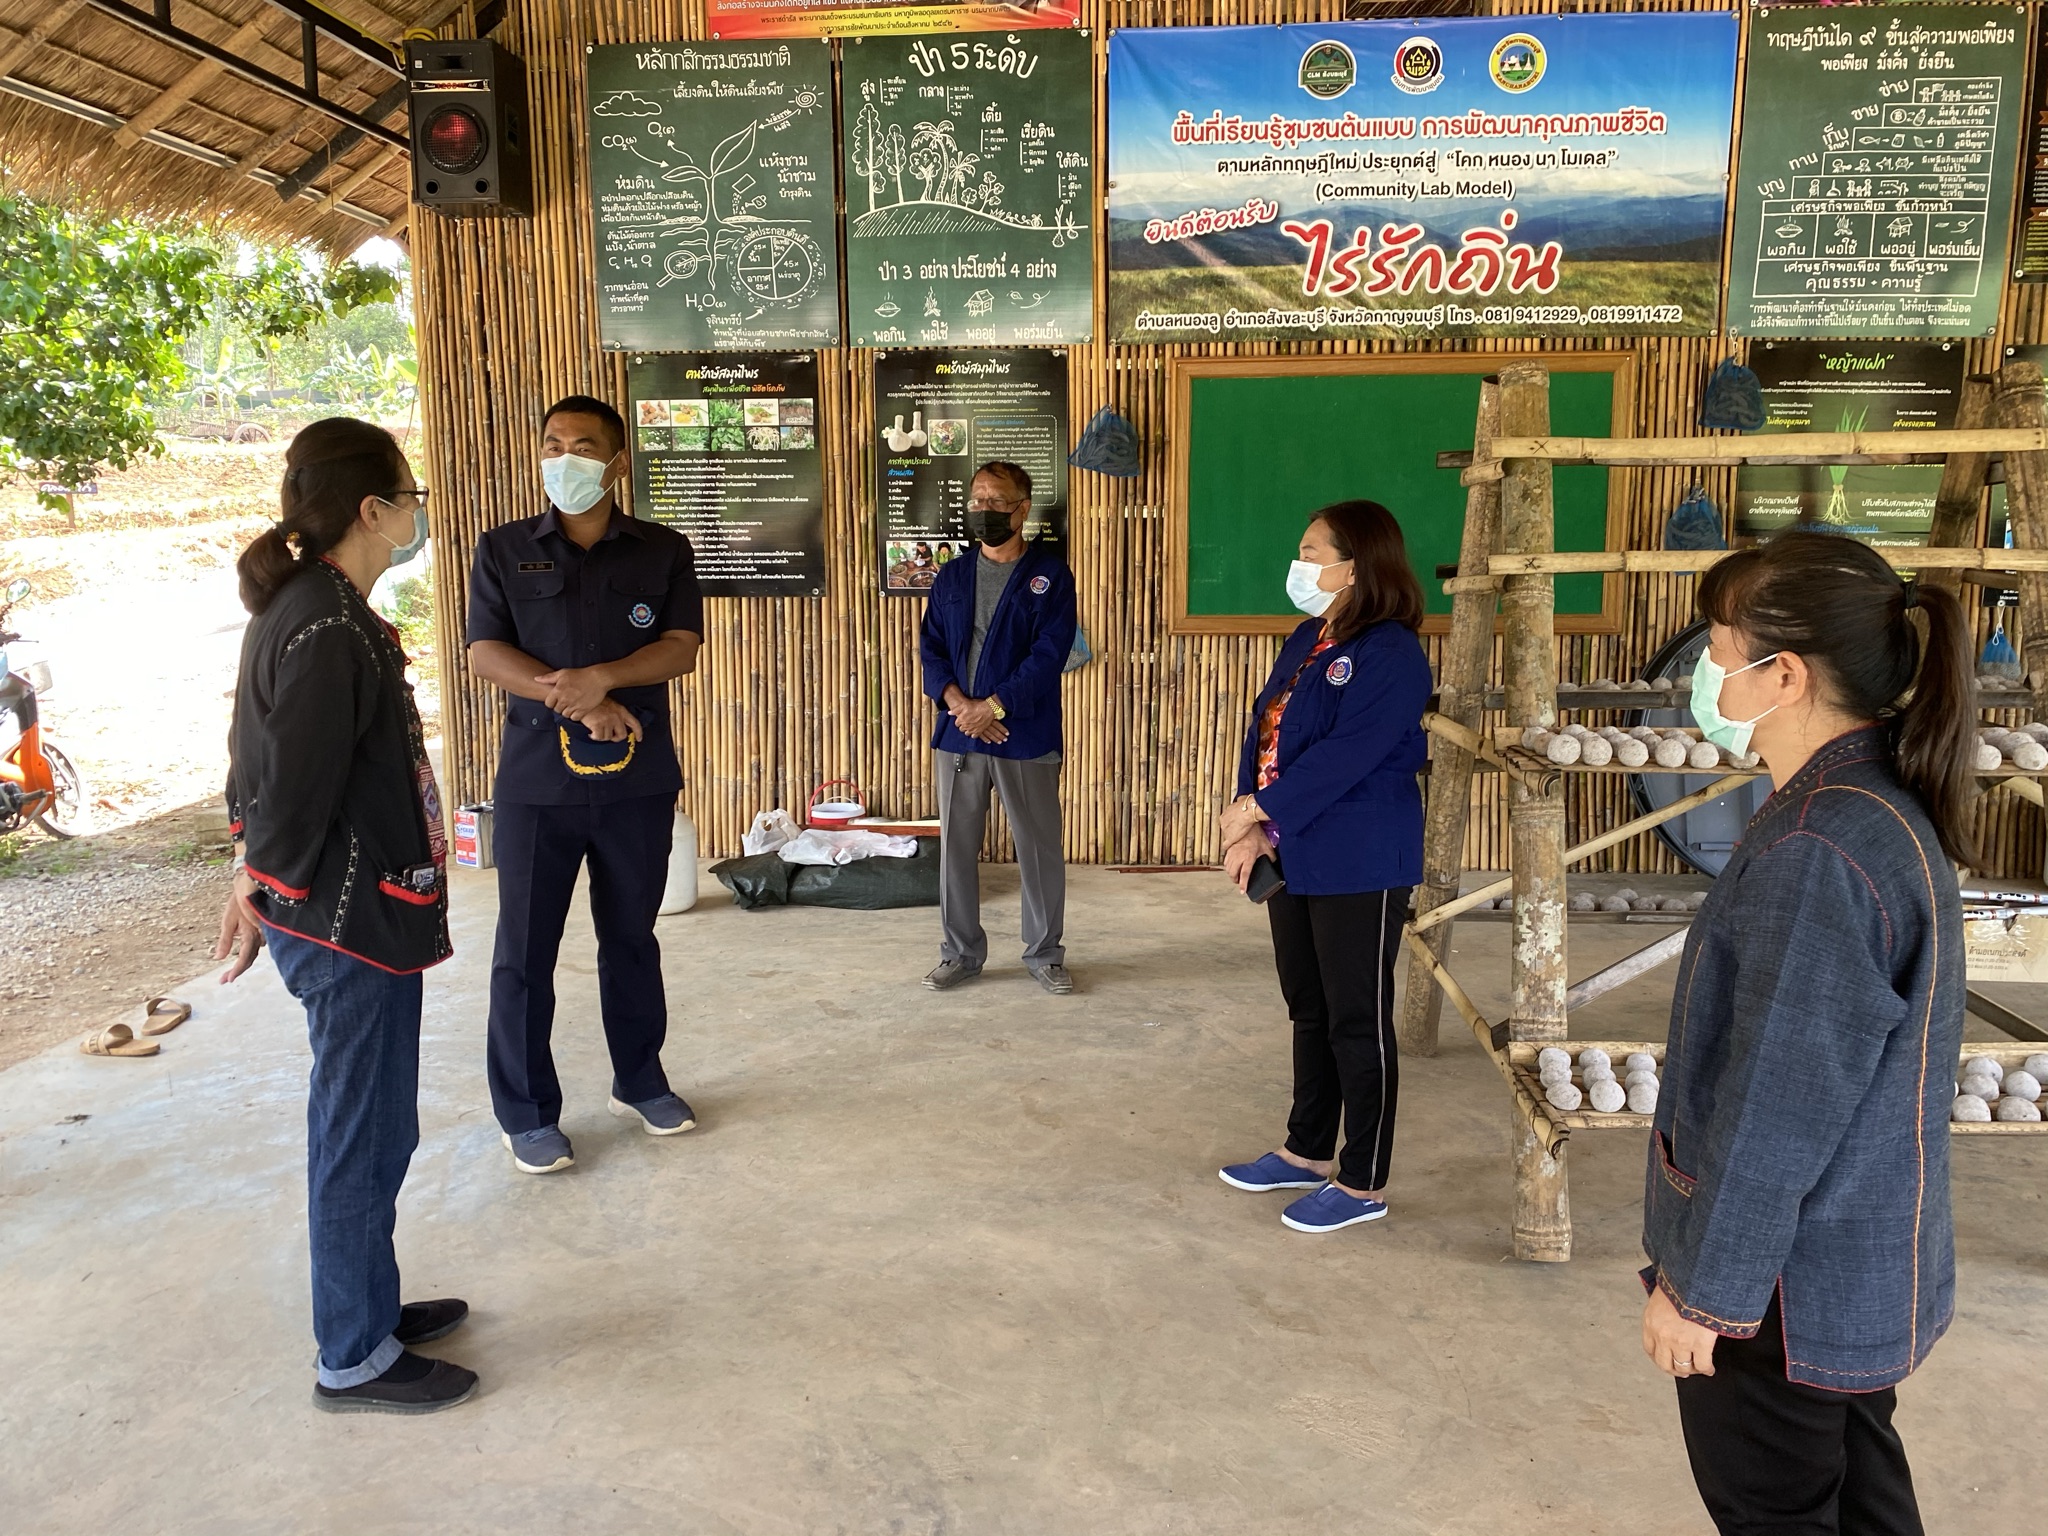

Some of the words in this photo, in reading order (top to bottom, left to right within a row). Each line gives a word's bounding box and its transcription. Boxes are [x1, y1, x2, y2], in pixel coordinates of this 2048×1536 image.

[1767, 23, 1853, 50] ทฤษฎีบันได
[1859, 27, 1877, 46] ๙
[1886, 18, 2015, 52] ขั้นสู่ความพอเพียง
[635, 45, 791, 70] หลักกสิกรรมธรรมชาติ
[908, 40, 946, 77] ป่า
[950, 43, 970, 70] 5
[973, 34, 1038, 79] ระดับ
[1821, 53, 1868, 70] พอเพียง
[1877, 49, 1908, 70] มั่งคั่ง
[1919, 50, 1955, 69] ยั่งยืน
[860, 79, 875, 101] สูง
[919, 85, 944, 98] กลาง
[1879, 79, 1909, 97] ข่าย
[981, 101, 1002, 123] เตี้ย
[1851, 103, 1879, 121] ขาย
[773, 121, 791, 132] แสง
[1021, 119, 1055, 138] เรี่ยดิน
[1173, 111, 1414, 147] พื้นที่เรียนรู้ชุมชนต้นแบบ
[1422, 109, 1664, 142] การพัฒนาคุณภาพชีวิต
[1822, 122, 1849, 145] เก็บ
[759, 152, 808, 168] แห้งชาม
[1056, 151, 1088, 168] ใต้ดิน
[1217, 153, 1358, 174] ตามหลักทฤษฎีใหม่
[1362, 148, 1436, 174] ประยุกต์สู่
[1488, 152, 1530, 168] หนอง
[1536, 152, 1555, 166] นา
[1789, 153, 1818, 170] ทาน
[615, 174, 655, 190] ห่มดิน
[777, 168, 816, 183] น้ำชาม
[779, 187, 812, 199] บำรุงดิน
[1316, 183, 1416, 202] (Community
[1421, 182, 1450, 196] Lab
[1456, 180, 1514, 199] Model)
[1758, 178, 1785, 199] บุญ
[1791, 200, 1885, 213] เศรษฐกิจพอเพียง
[1895, 199, 1953, 211] ขั้นก้าวหน้า
[1146, 200, 1276, 241] ยินดีต้อนรับ
[1284, 212, 1559, 293] ไร่รักถิ่น
[1767, 242, 1806, 256] พอกิน
[1825, 237, 1857, 255] พอใช้
[1881, 240, 1916, 257] พออยู่
[1929, 238, 1980, 256] พอร่มเย็น
[878, 261, 897, 280] ป่า
[902, 265, 912, 280] 3
[920, 258, 948, 280] อย่าง
[951, 252, 1007, 279] ประโยชน์
[1010, 263, 1020, 278] 4
[1026, 257, 1056, 279] อย่าง
[1784, 260, 1880, 275] เศรษฐกิจพอเพียง
[1889, 259, 1948, 275] ขั้นพื้นฐาน
[604, 280, 649, 292] รากขนอ่อน
[747, 273, 771, 282] อากาศ
[1805, 277, 1866, 293] คุณธรรม
[1881, 275, 1923, 292] ความรู้
[610, 304, 644, 313] สารอาหาร
[706, 312, 742, 328] จุลินทรีย์
[1138, 312, 1218, 331] ตำบลหนองลู
[1226, 310, 1324, 330] อำเภอสังขละบุรี
[1329, 308, 1441, 328] จังหวัดกาญจนบุรี
[873, 326, 906, 343] พอกิน
[921, 320, 948, 342] พอใช้
[966, 324, 996, 344] พออยู่
[1014, 320, 1063, 339] พอร่มเย็น
[888, 457, 931, 468] การทำลูกประคบ
